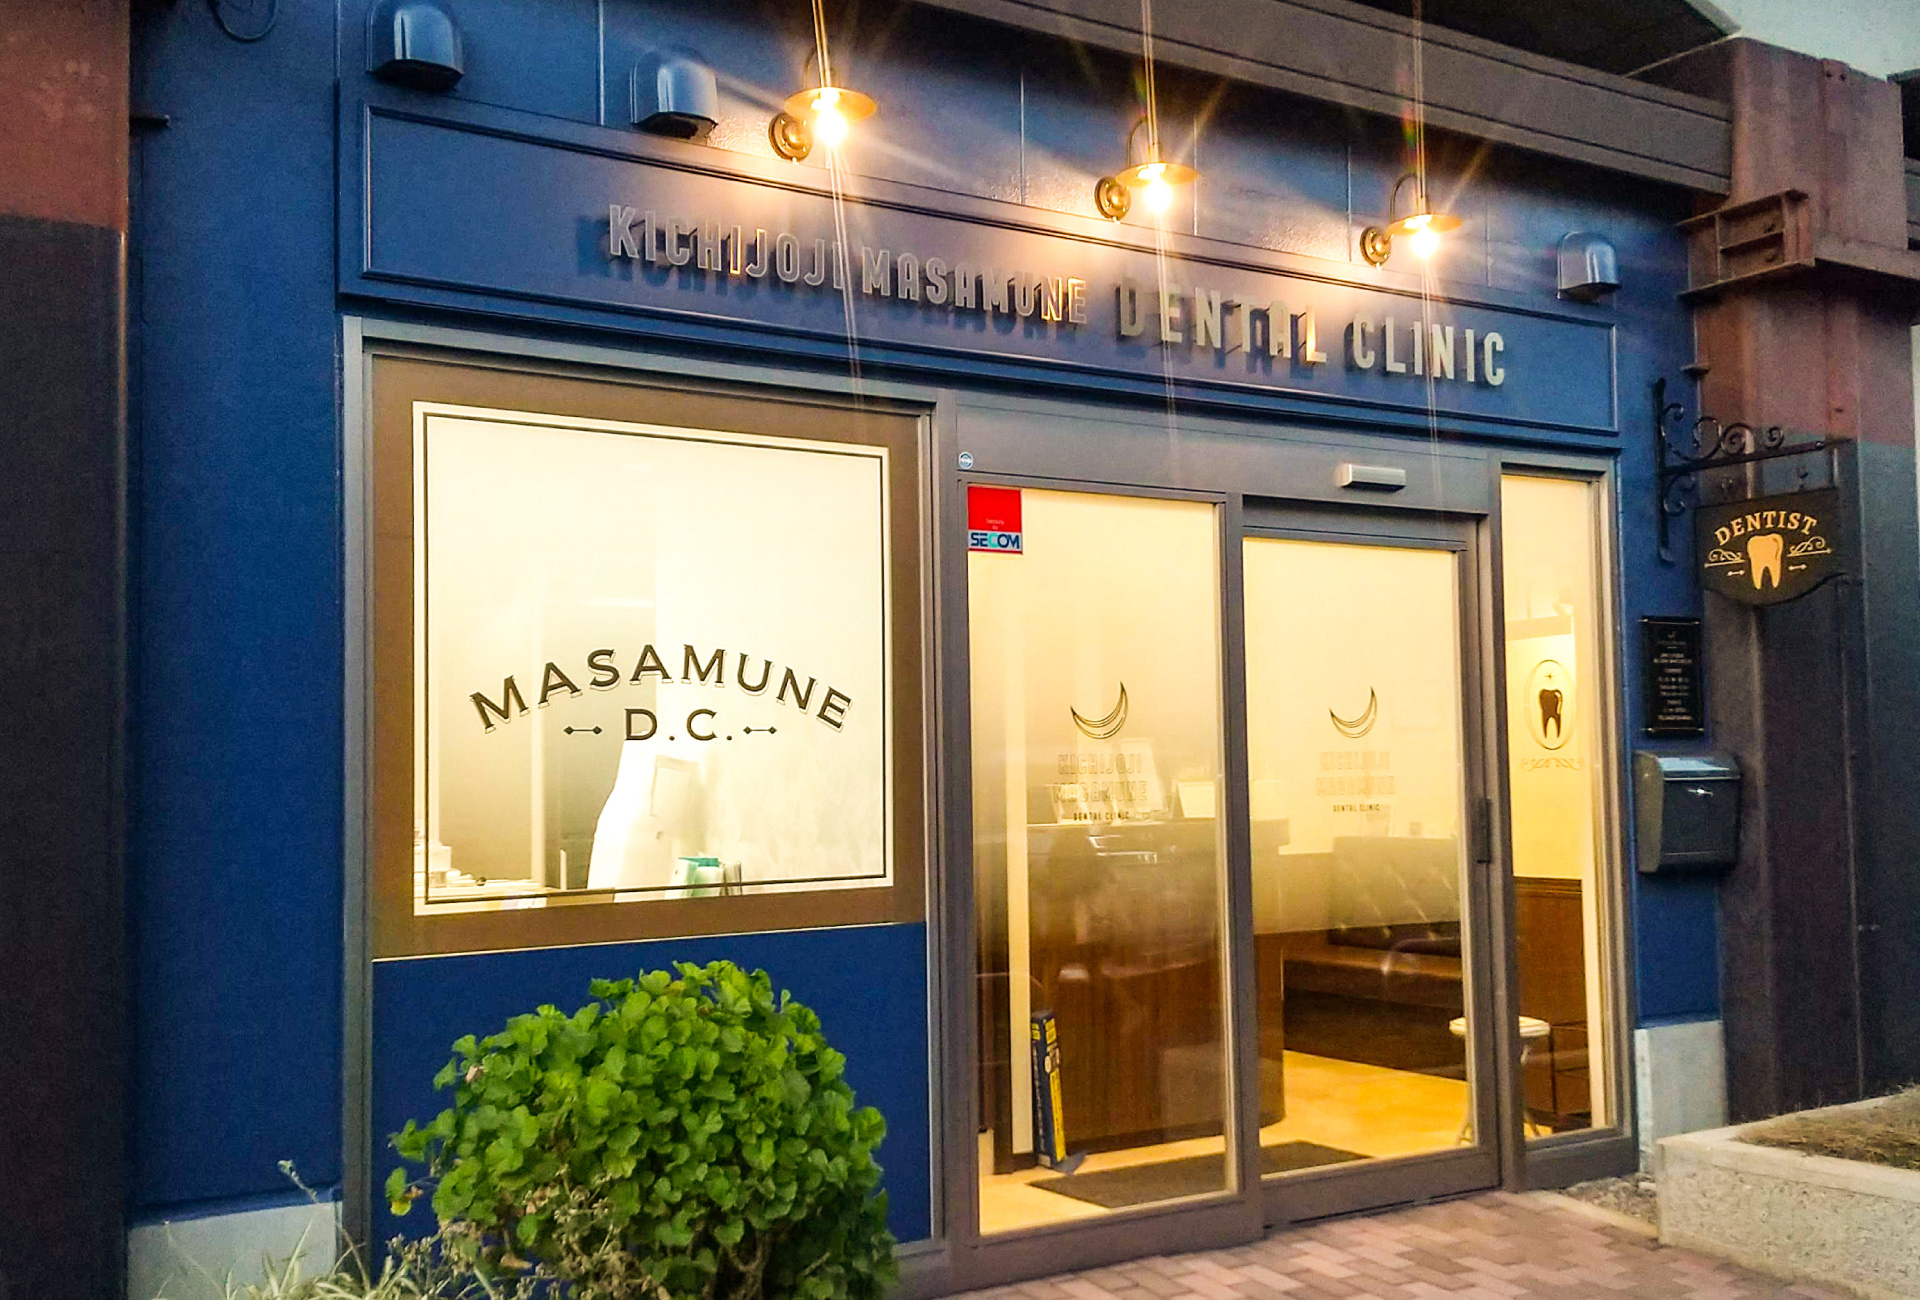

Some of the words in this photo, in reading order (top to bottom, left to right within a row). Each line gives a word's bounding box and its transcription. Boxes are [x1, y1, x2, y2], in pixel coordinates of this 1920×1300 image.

[608, 203, 844, 290] KICHIJOJI
[861, 245, 1087, 324] MASAMUNE
[1118, 276, 1328, 364] DENTAL
[1352, 310, 1505, 387] CLINIC
[970, 532, 1020, 549] SECOM
[1714, 510, 1818, 546] DENTIST
[468, 643, 852, 734] MASAMUNE
[623, 708, 734, 741] D.C.
